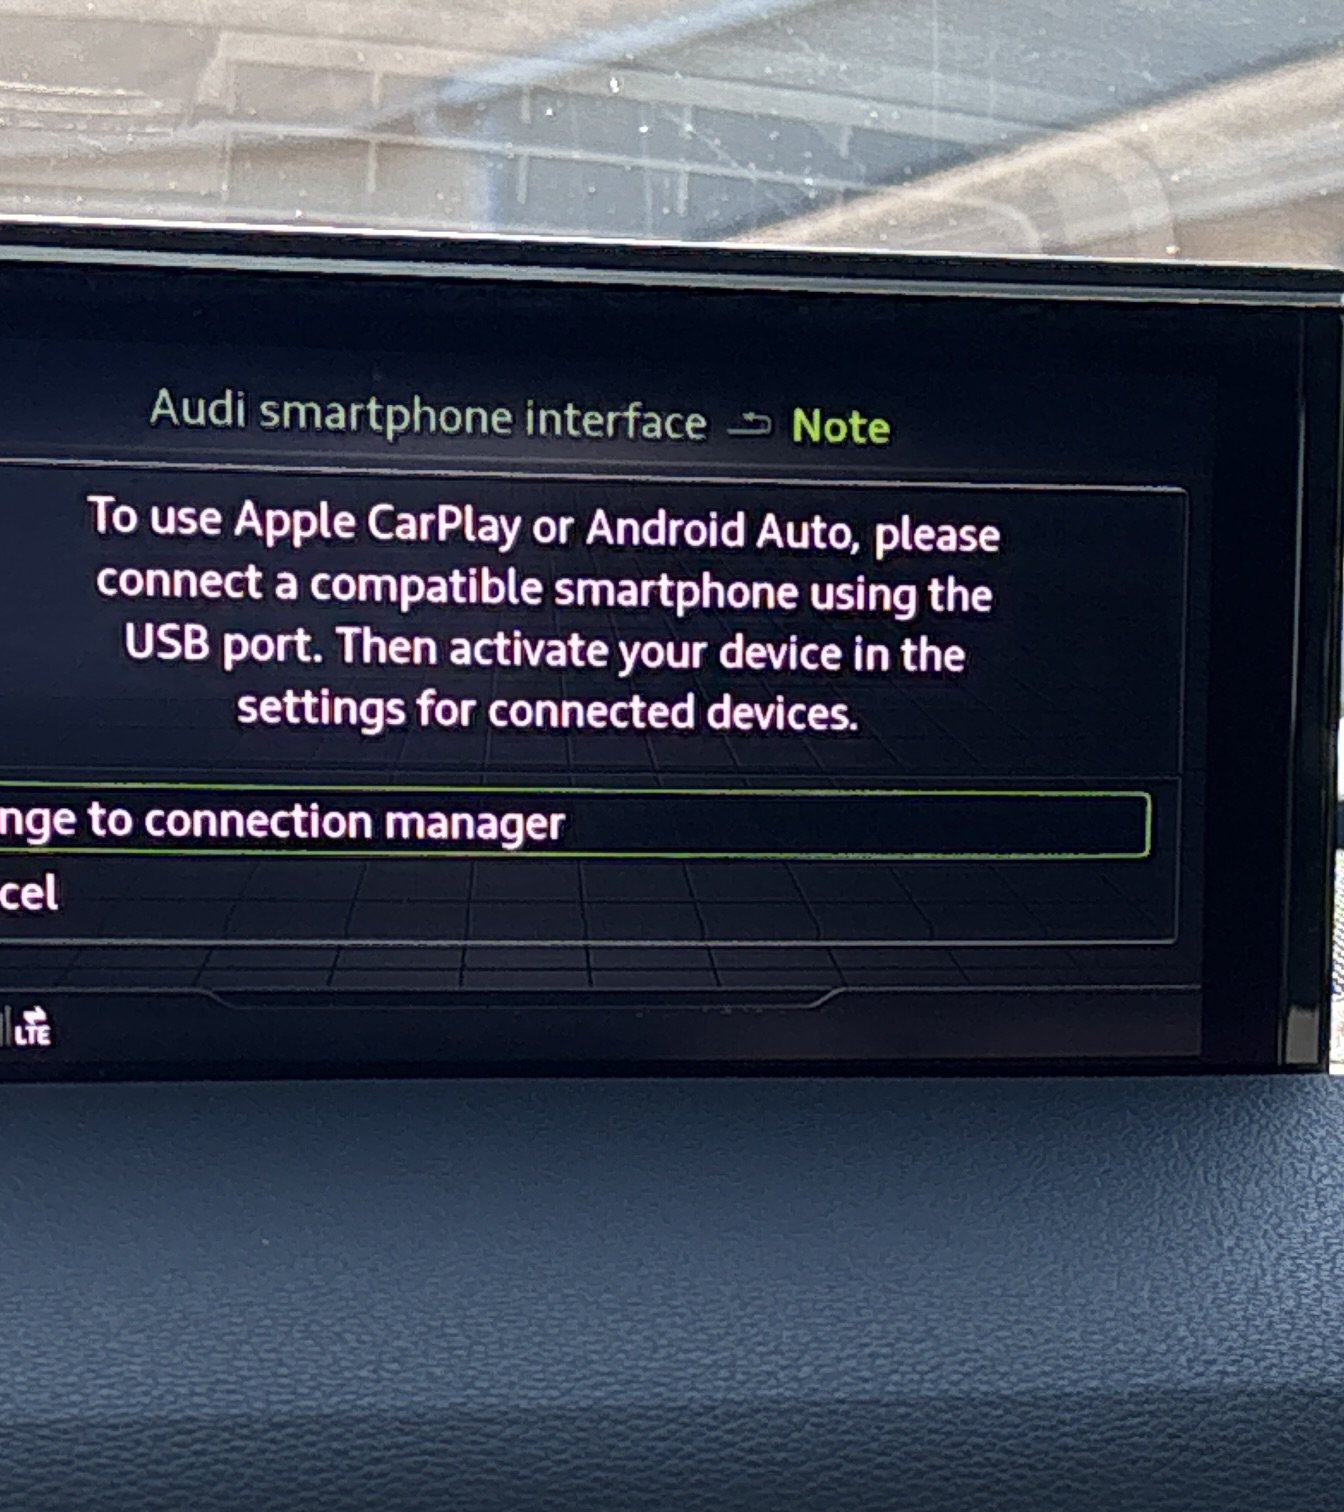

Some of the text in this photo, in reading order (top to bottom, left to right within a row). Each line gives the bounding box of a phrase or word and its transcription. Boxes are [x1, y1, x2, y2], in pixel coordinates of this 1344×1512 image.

[151, 388, 890, 443] Audi smartphone interface Note
[87, 496, 1000, 560] To use Apple CarPlay or Android Auto, please
[97, 564, 992, 620] connect a compatible smartphone using the
[126, 623, 965, 677] USB port. Then activate your device in the
[238, 688, 857, 735] settings for connected devices.
[87, 802, 132, 836] to
[145, 803, 372, 838] connection
[386, 812, 565, 850] manager
[15, 1025, 51, 1045] LTE
